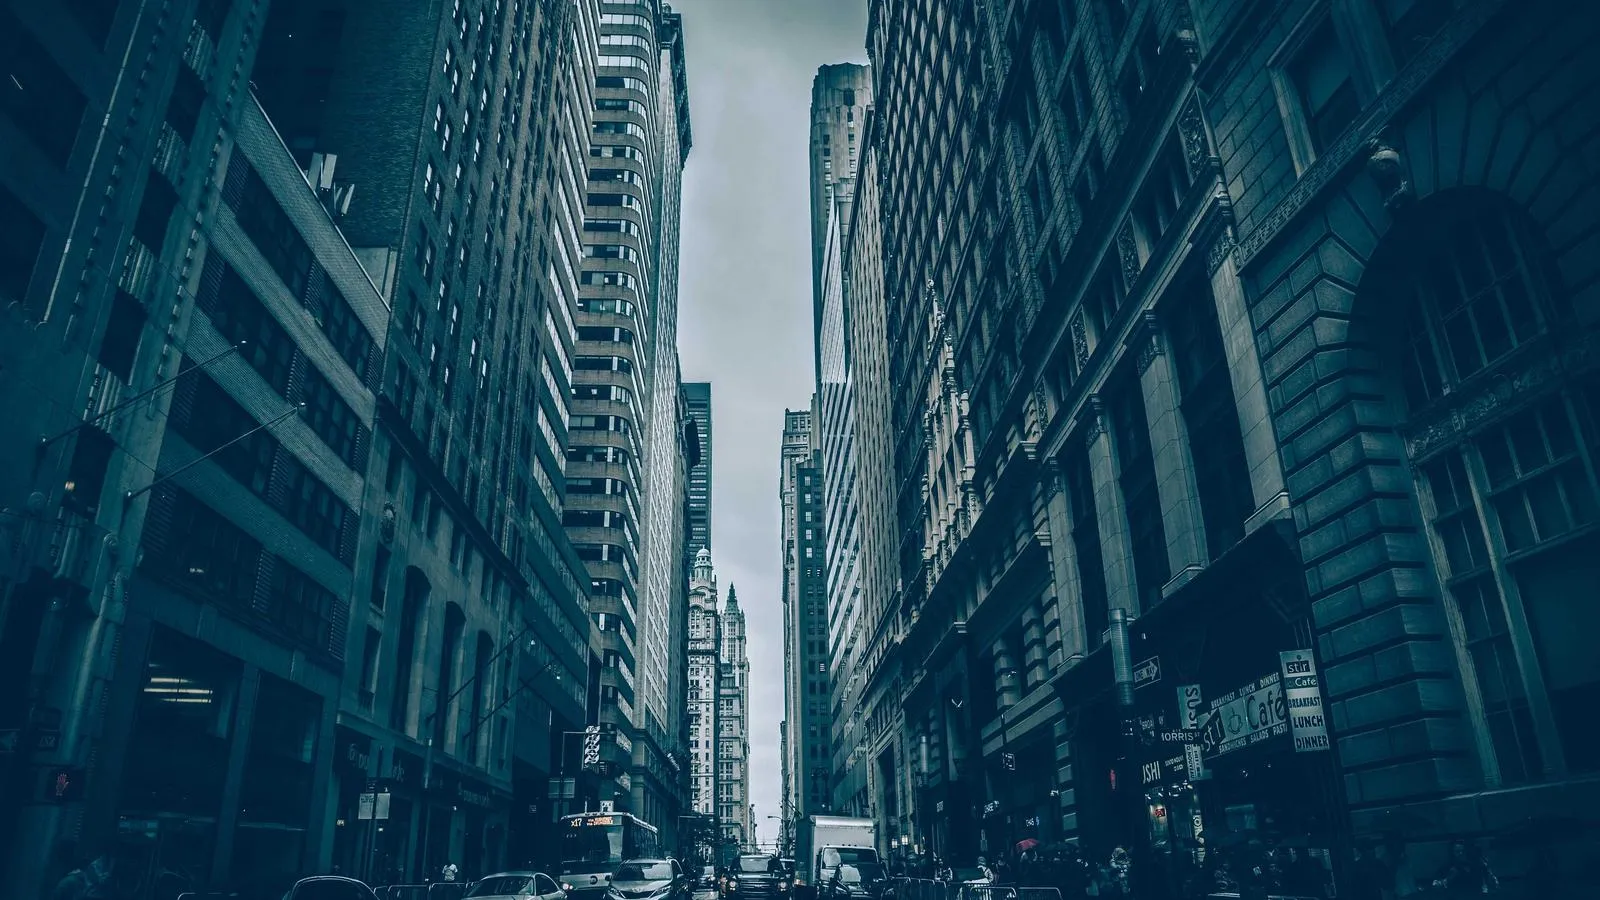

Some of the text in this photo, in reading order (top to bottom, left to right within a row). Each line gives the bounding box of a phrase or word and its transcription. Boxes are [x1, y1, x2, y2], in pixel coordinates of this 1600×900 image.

[1288, 662, 1307, 673] stir
[1287, 697, 1321, 708] BREAKFAST
[1203, 717, 1222, 752] str
[1246, 687, 1287, 730] Café
[1293, 715, 1323, 729] LUNCH
[1296, 735, 1329, 749] DINNER
